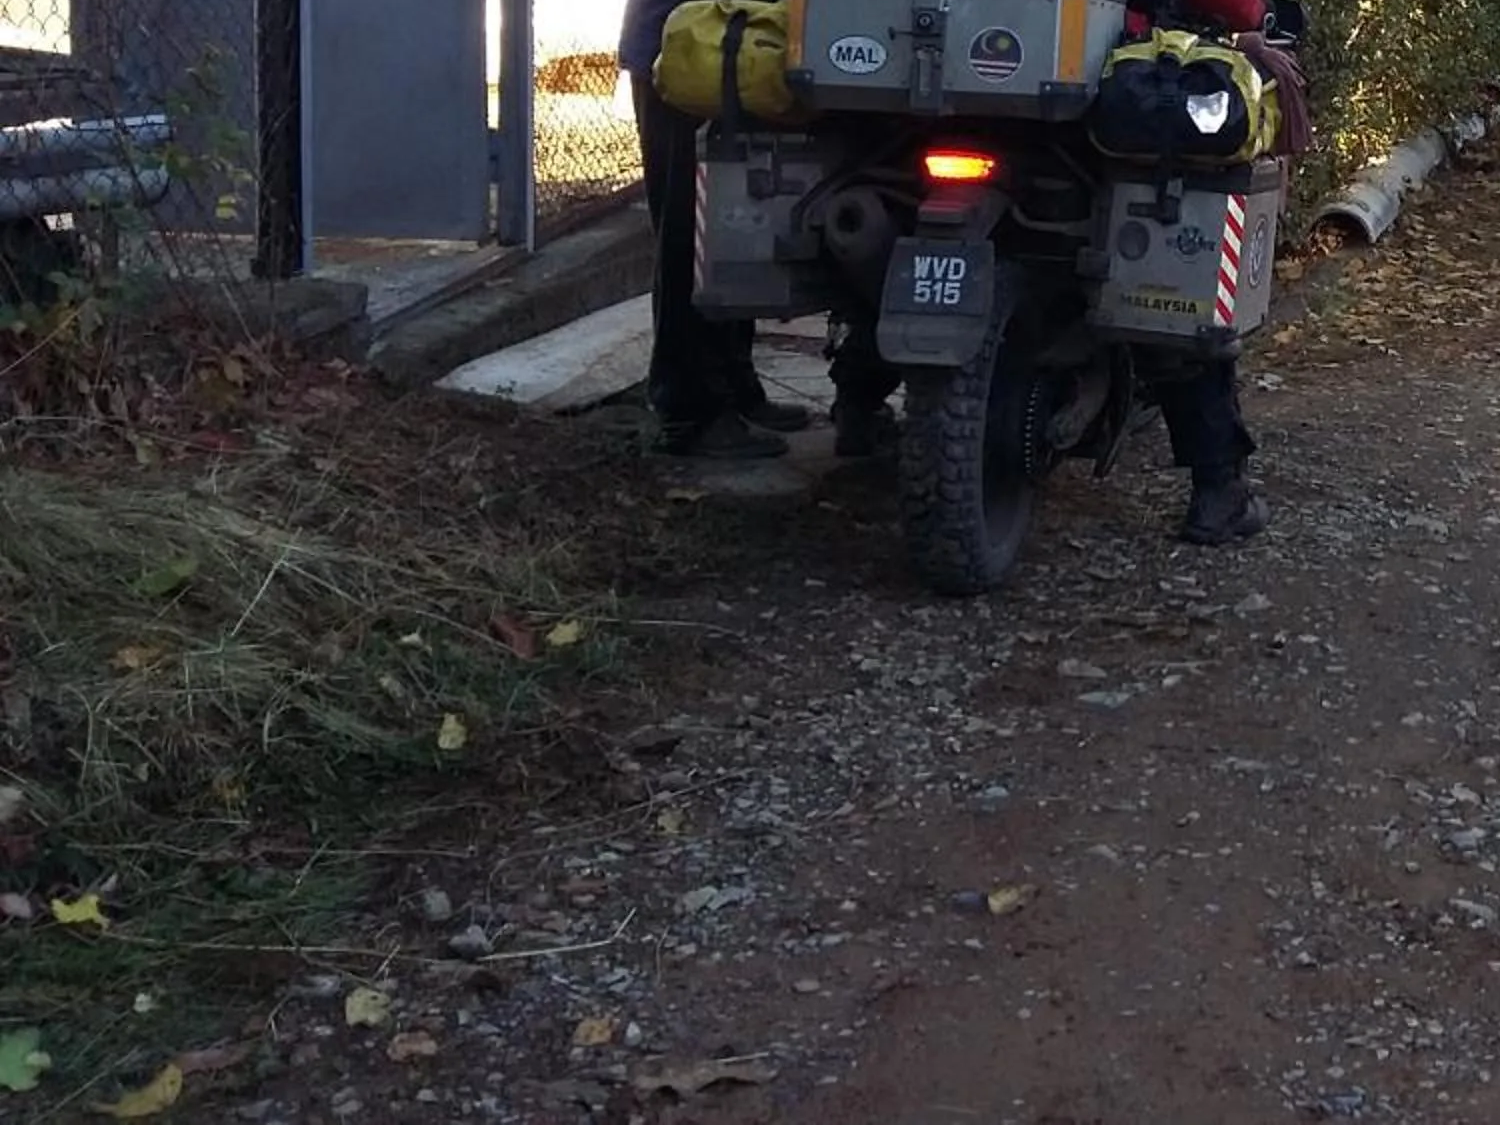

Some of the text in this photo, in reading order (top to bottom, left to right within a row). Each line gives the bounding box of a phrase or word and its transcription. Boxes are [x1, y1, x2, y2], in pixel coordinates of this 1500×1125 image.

[835, 46, 879, 64] MAL
[913, 256, 966, 280] WVD
[913, 280, 961, 304] 515
[1119, 291, 1198, 314] MALAYSIA
